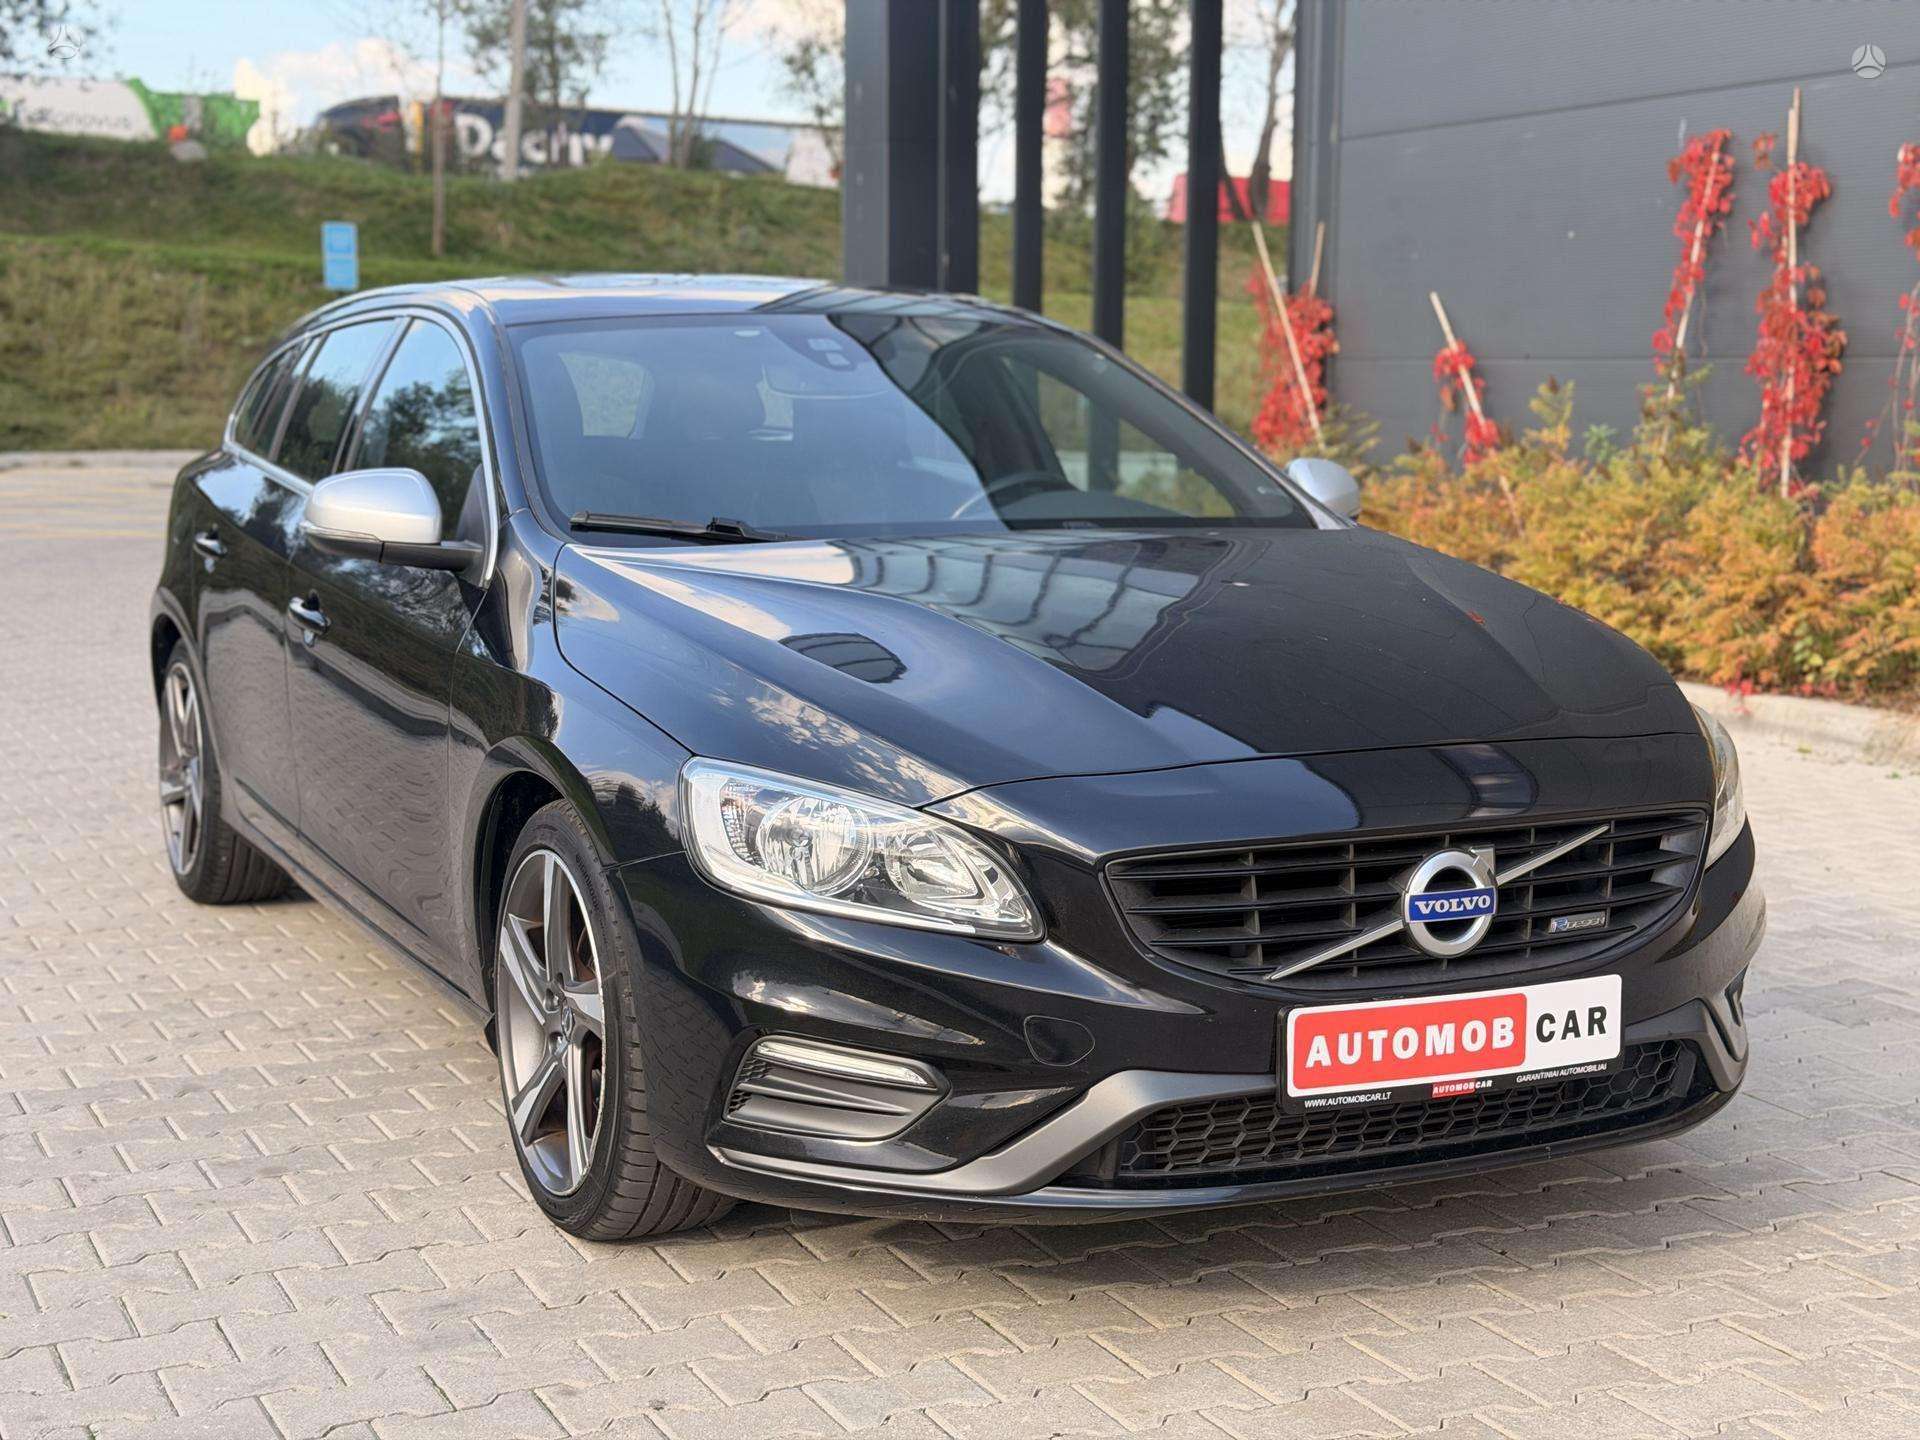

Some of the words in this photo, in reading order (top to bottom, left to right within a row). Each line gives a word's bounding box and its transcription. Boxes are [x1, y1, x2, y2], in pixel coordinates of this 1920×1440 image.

[1415, 894, 1491, 914] VOLVO
[1304, 1016, 1516, 1068] AUTOMOB
[1535, 1005, 1608, 1043] CAR
[1516, 1070, 1559, 1083] GARANTINIAI
[1559, 1062, 1608, 1077] AUTOMOBILIAI
[1304, 1091, 1392, 1108] WWW.AUTOMOBCAR.LT
